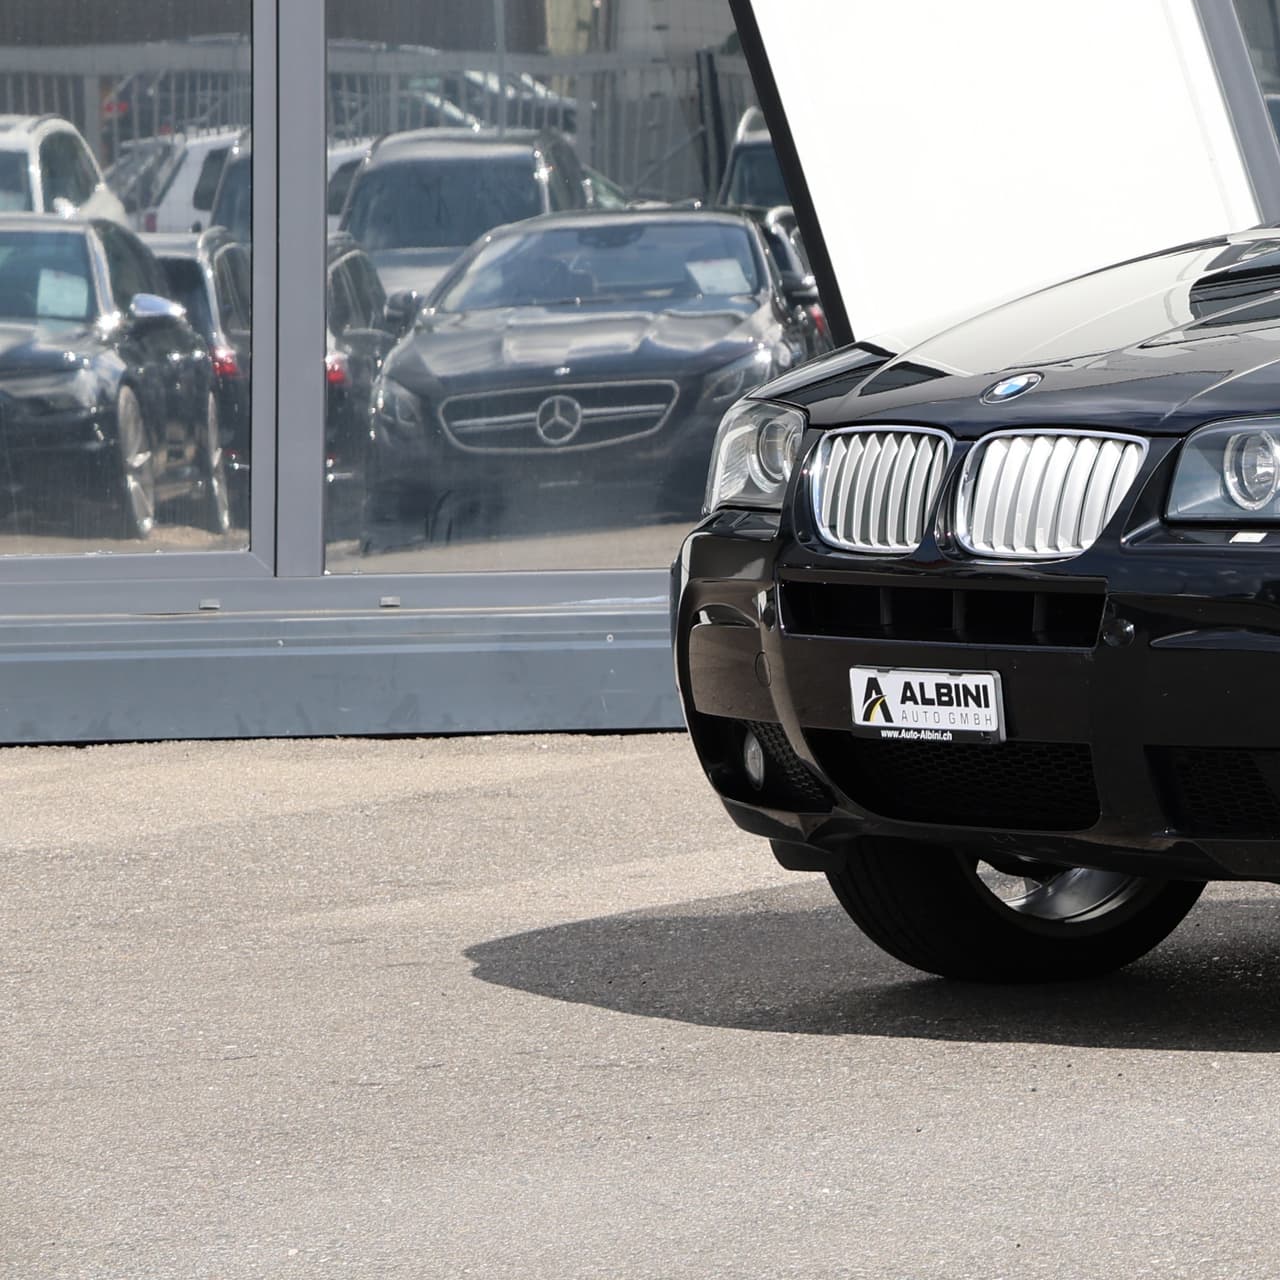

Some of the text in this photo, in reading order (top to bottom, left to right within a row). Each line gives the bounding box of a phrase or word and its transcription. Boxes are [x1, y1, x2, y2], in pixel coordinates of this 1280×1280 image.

[900, 681, 991, 709] ALBINI
[901, 710, 992, 726] AUTO GMBH
[880, 729, 952, 742] www.Auto-Albini.ch
